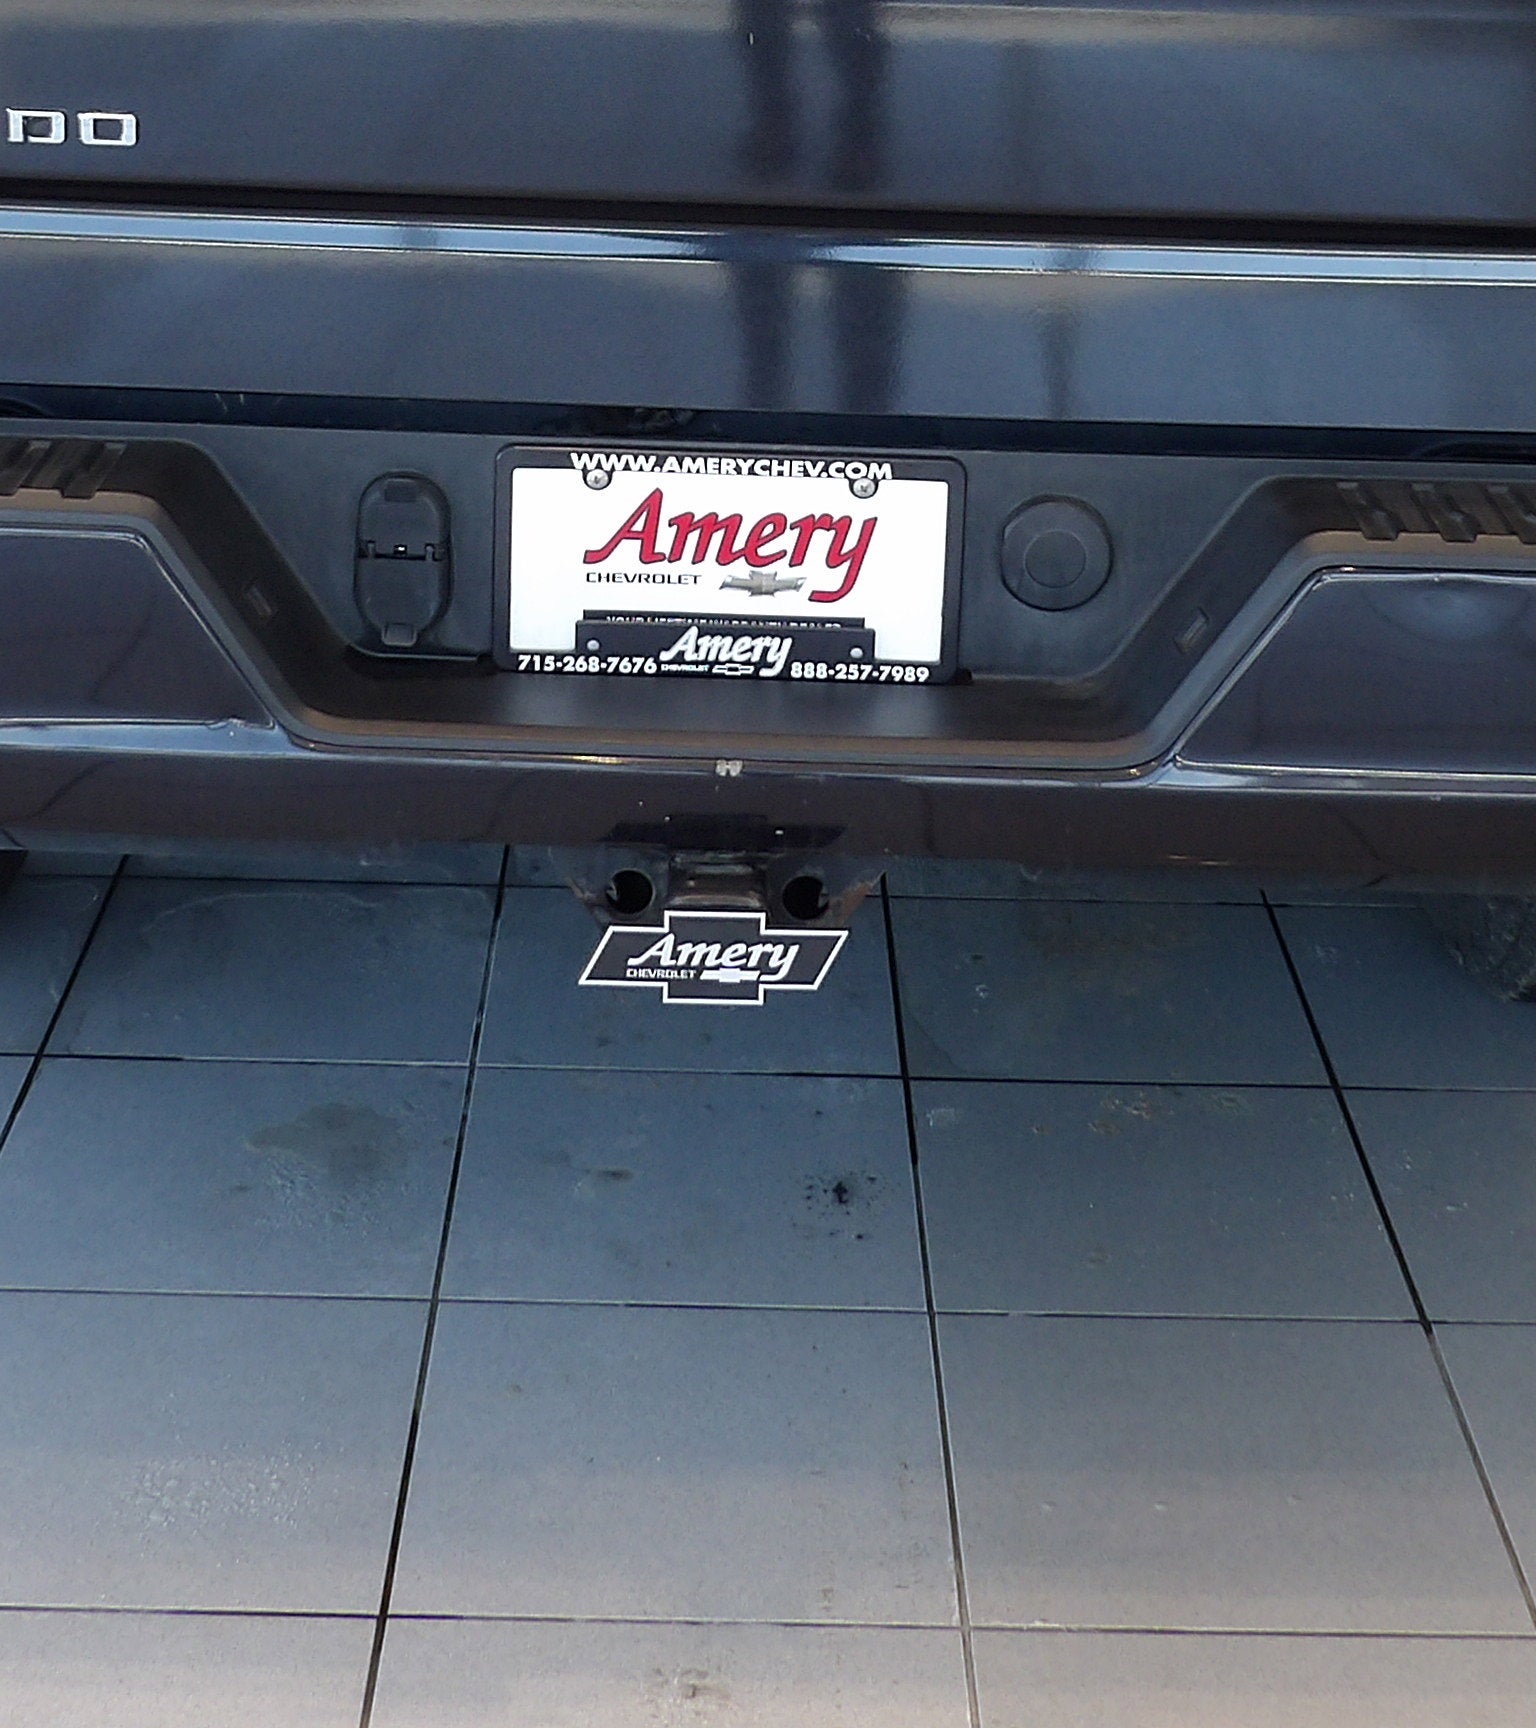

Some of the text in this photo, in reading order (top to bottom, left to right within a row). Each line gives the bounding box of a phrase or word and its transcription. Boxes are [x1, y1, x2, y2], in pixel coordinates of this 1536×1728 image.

[570, 452, 893, 480] WWW.AMERYCHEV.COM
[582, 487, 878, 603] Amery
[585, 571, 702, 586] CHEVROLET
[659, 625, 793, 677] Amery
[517, 654, 657, 674] 715-268-7676
[790, 661, 930, 683] 888-257-7989
[627, 933, 800, 982] Amery
[626, 968, 697, 980] CHEVROLET
